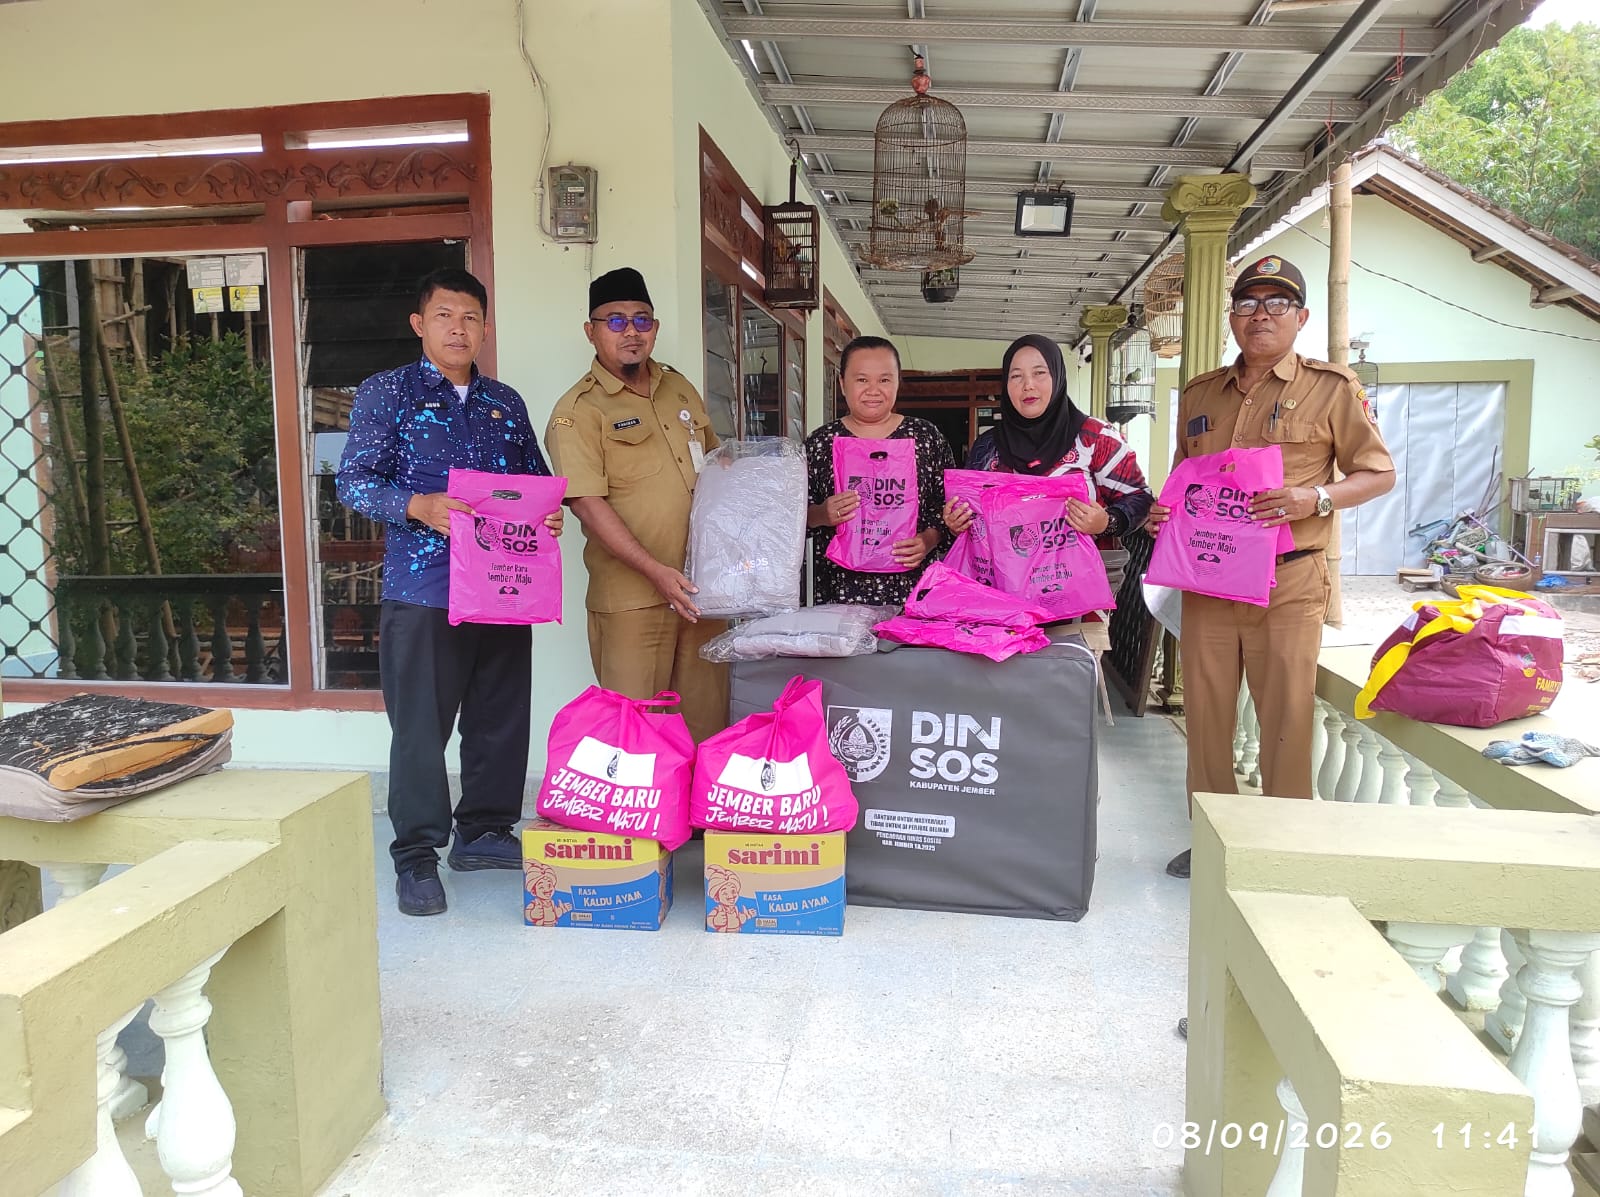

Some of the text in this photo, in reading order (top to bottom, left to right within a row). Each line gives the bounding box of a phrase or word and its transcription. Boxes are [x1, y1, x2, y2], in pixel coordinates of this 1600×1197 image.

[875, 478, 905, 491] DIN
[874, 493, 905, 506] SOS
[502, 522, 537, 538] DIN
[1194, 529, 1234, 542] Jember Baru
[501, 538, 538, 552] SOS
[1043, 530, 1078, 549] SOS
[1186, 537, 1237, 554] Jember Maju
[487, 572, 533, 585] Jember Maju
[911, 710, 1001, 750] DIN
[909, 747, 999, 784] SOS
[551, 768, 661, 809] JEMBER BARU
[909, 781, 996, 796] KABUPATEN JEMBER
[707, 784, 822, 816] JEMBER BARU
[543, 790, 661, 837] JEMBER MAJU !
[705, 805, 830, 833] JEMBER MAJU !
[544, 837, 633, 861] sarimi
[728, 843, 820, 865] sarimi
[578, 888, 597, 896] RASA
[583, 890, 643, 907] KALDU AYAM
[763, 894, 782, 902] RASA
[768, 895, 830, 913] KALDU AYAM
